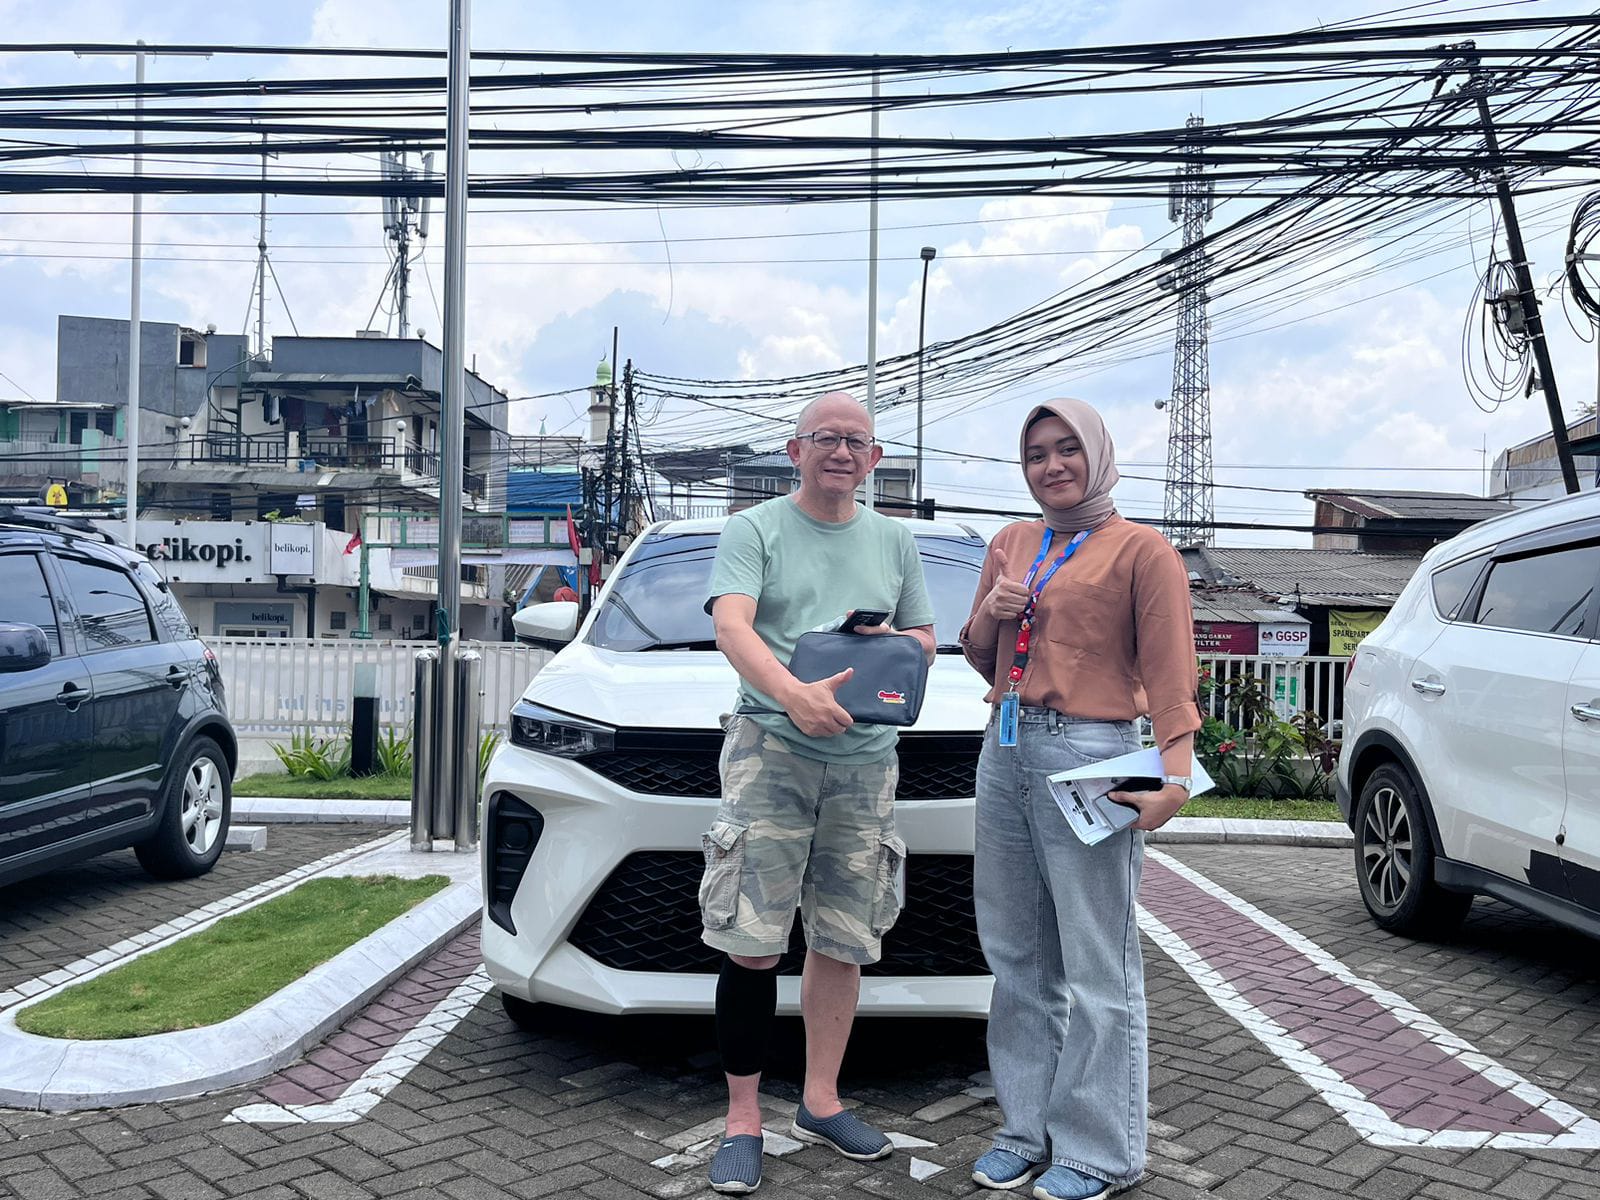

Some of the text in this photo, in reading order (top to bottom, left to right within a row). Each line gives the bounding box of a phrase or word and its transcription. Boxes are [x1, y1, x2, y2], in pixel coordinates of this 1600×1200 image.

[274, 543, 311, 555] belikopi.
[251, 612, 288, 623] belikopi.
[1276, 630, 1308, 642] GGSP
